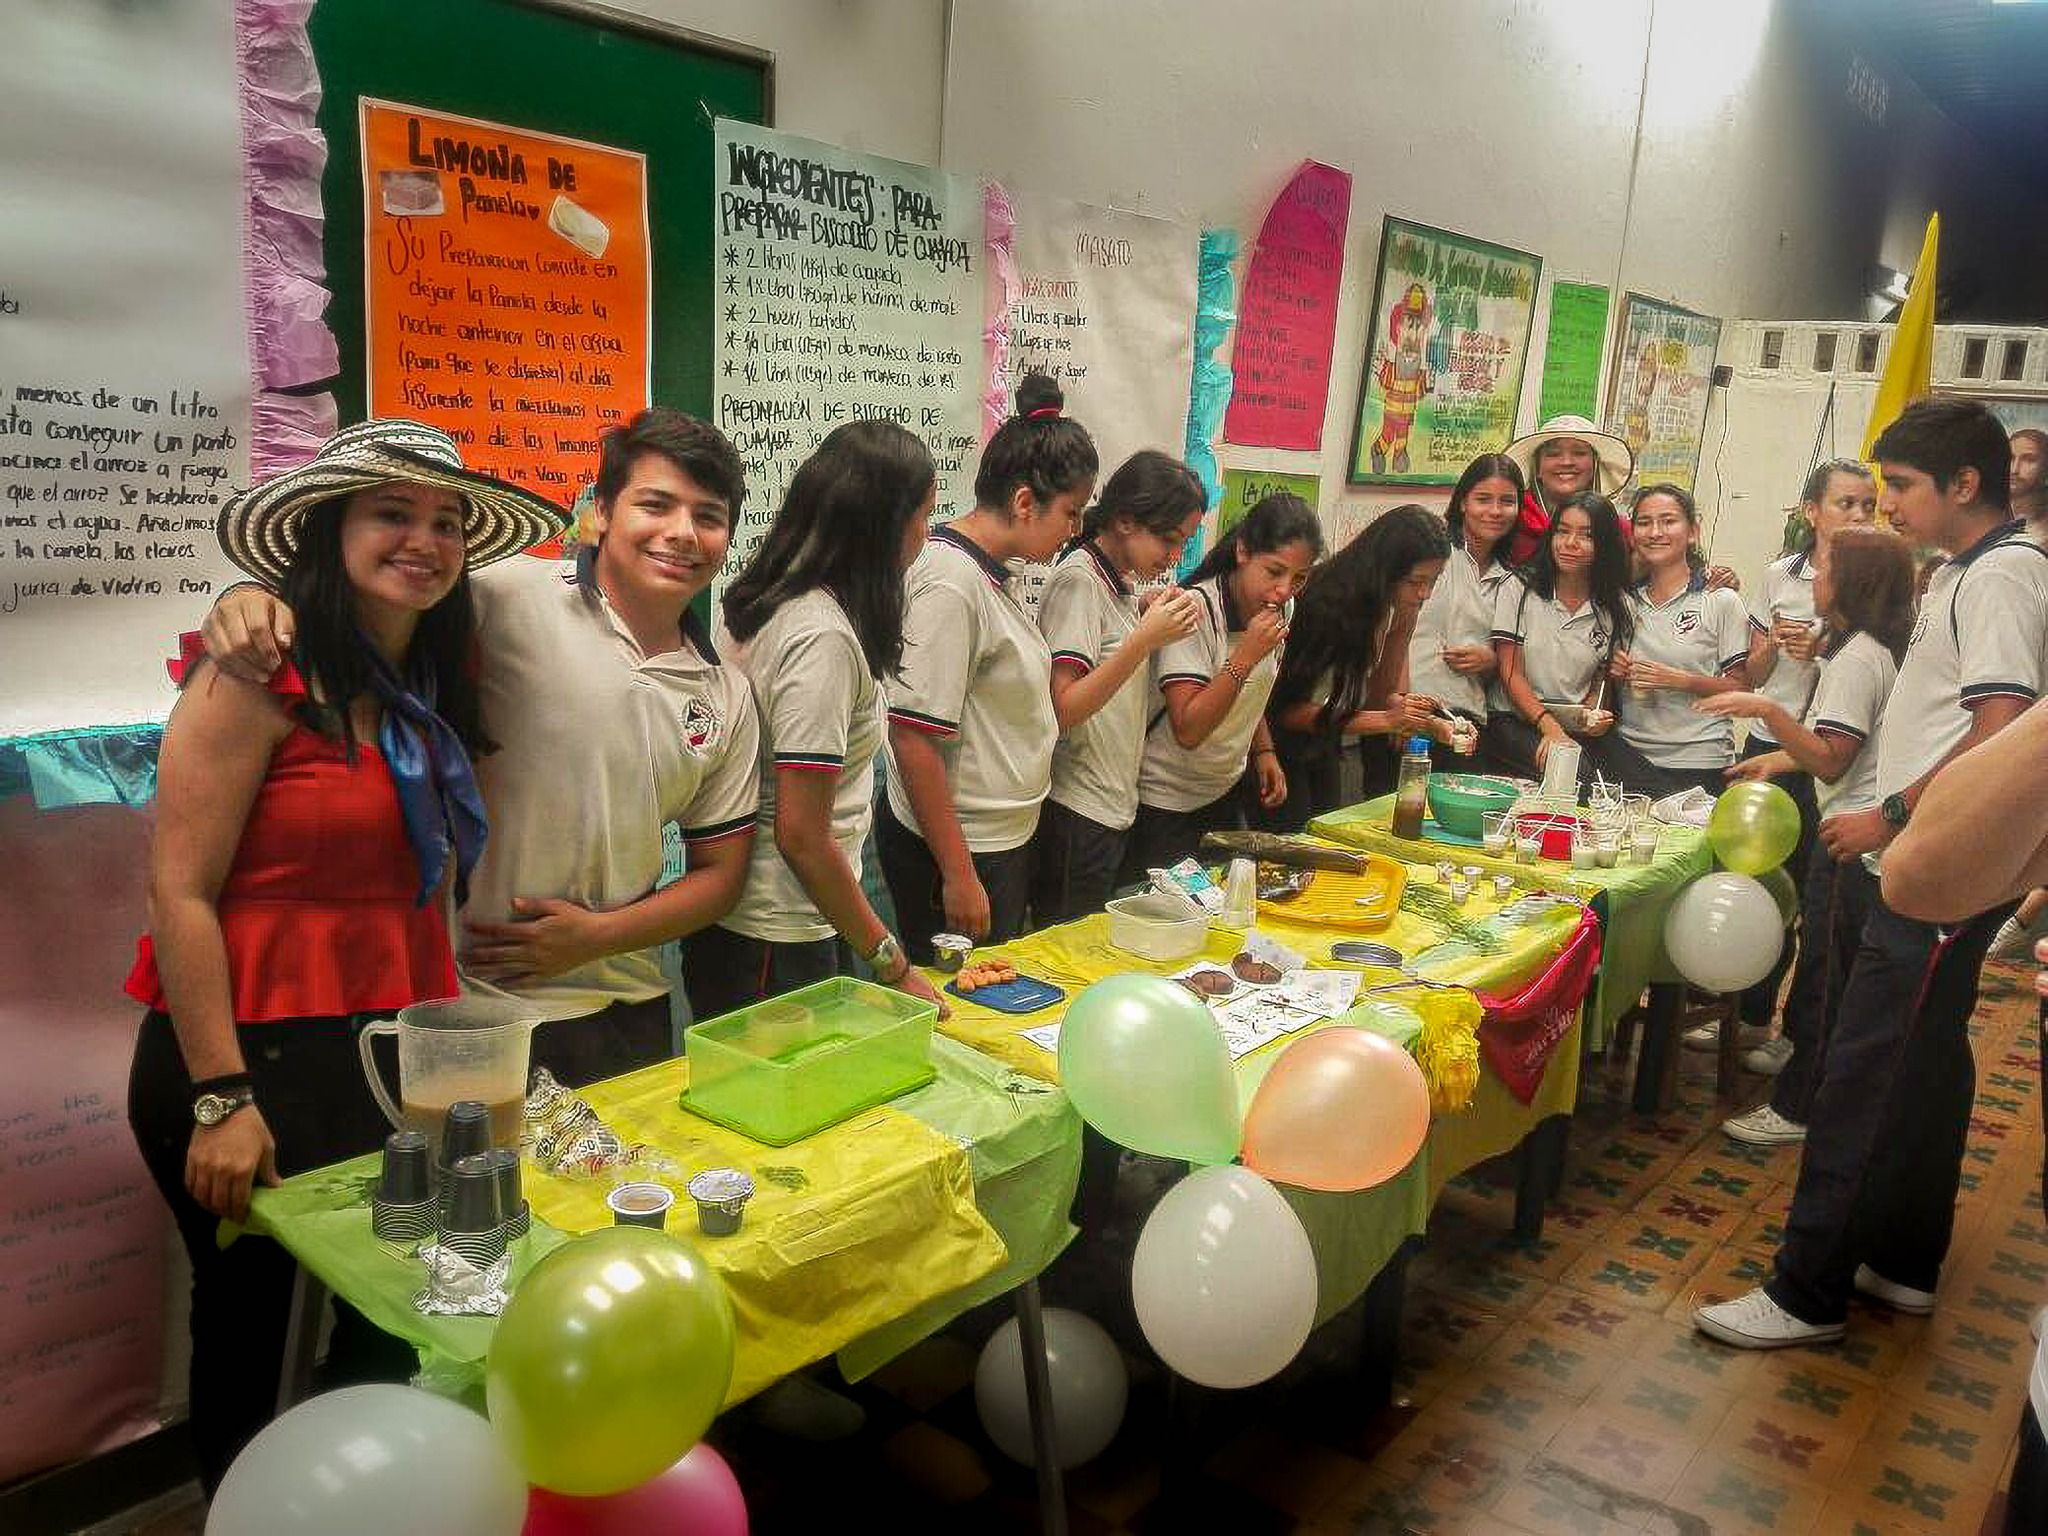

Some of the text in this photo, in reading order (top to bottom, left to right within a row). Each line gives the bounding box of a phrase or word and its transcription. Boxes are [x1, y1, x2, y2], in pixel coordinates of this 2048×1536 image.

[548, 157, 577, 191] DE
[892, 186, 942, 230] PARA
[721, 192, 806, 240] PREPARAR
[886, 225, 908, 258] DE
[388, 217, 425, 275] Su
[747, 247, 760, 268] 2
[409, 270, 456, 307] dejar
[467, 275, 483, 305] la
[544, 291, 583, 315] desde
[593, 299, 608, 320] la
[748, 306, 762, 324] 2
[838, 336, 855, 357] de
[838, 365, 855, 384] de
[16, 387, 218, 419] menos de un litro
[489, 384, 505, 412] la
[824, 401, 845, 421] DE
[921, 405, 944, 427] DE
[192, 425, 237, 457] punto
[70, 450, 88, 471] el
[94, 458, 149, 473] arroz
[157, 464, 170, 479] a
[7, 483, 36, 508] que
[43, 480, 57, 502] el
[63, 486, 109, 503] arroz
[48, 510, 66, 530] el
[15, 539, 34, 559] la
[114, 541, 136, 560] los
[71, 577, 96, 596] de
